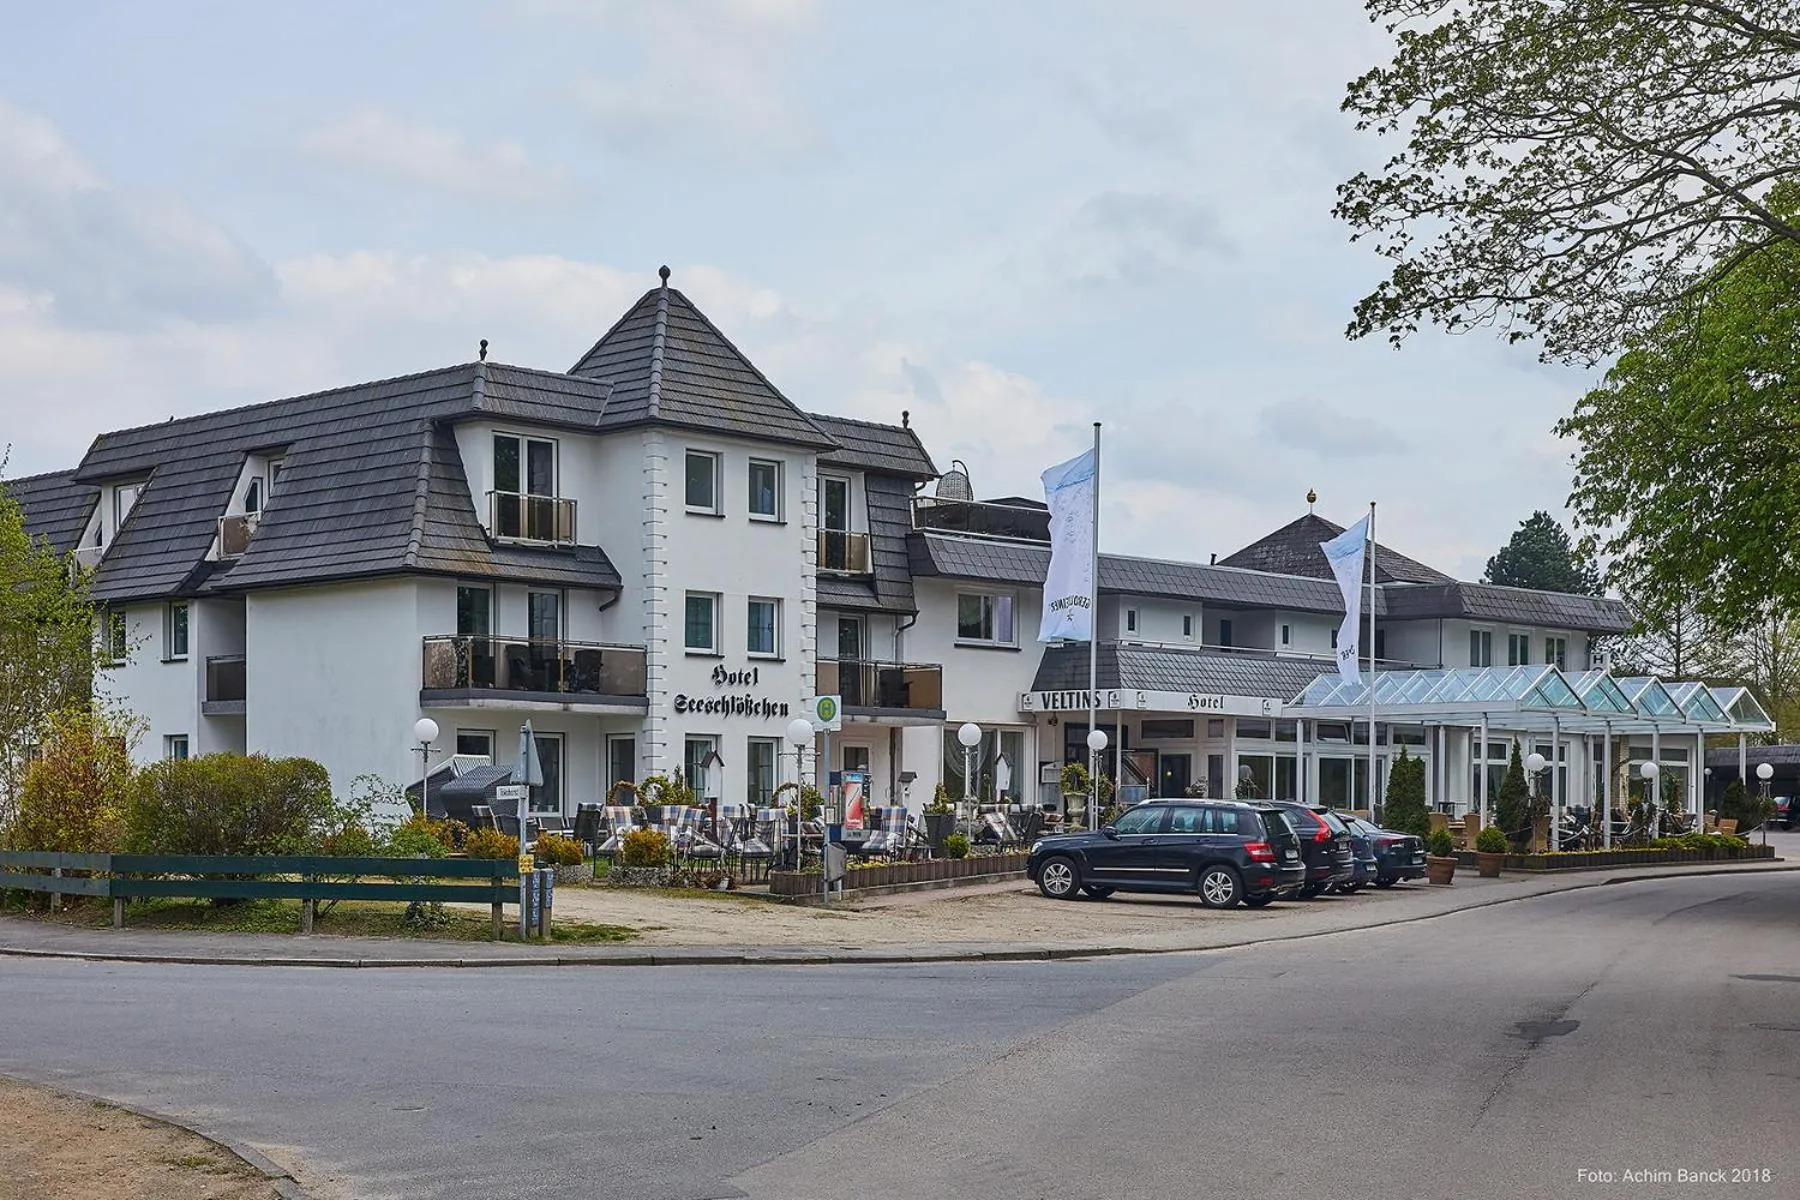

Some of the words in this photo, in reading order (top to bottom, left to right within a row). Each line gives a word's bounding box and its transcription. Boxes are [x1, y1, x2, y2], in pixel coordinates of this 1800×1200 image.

[711, 664, 759, 686] Hotel
[674, 693, 789, 720] Seeschlößchen
[1041, 691, 1101, 709] VELTINS
[1187, 694, 1225, 709] Hotel
